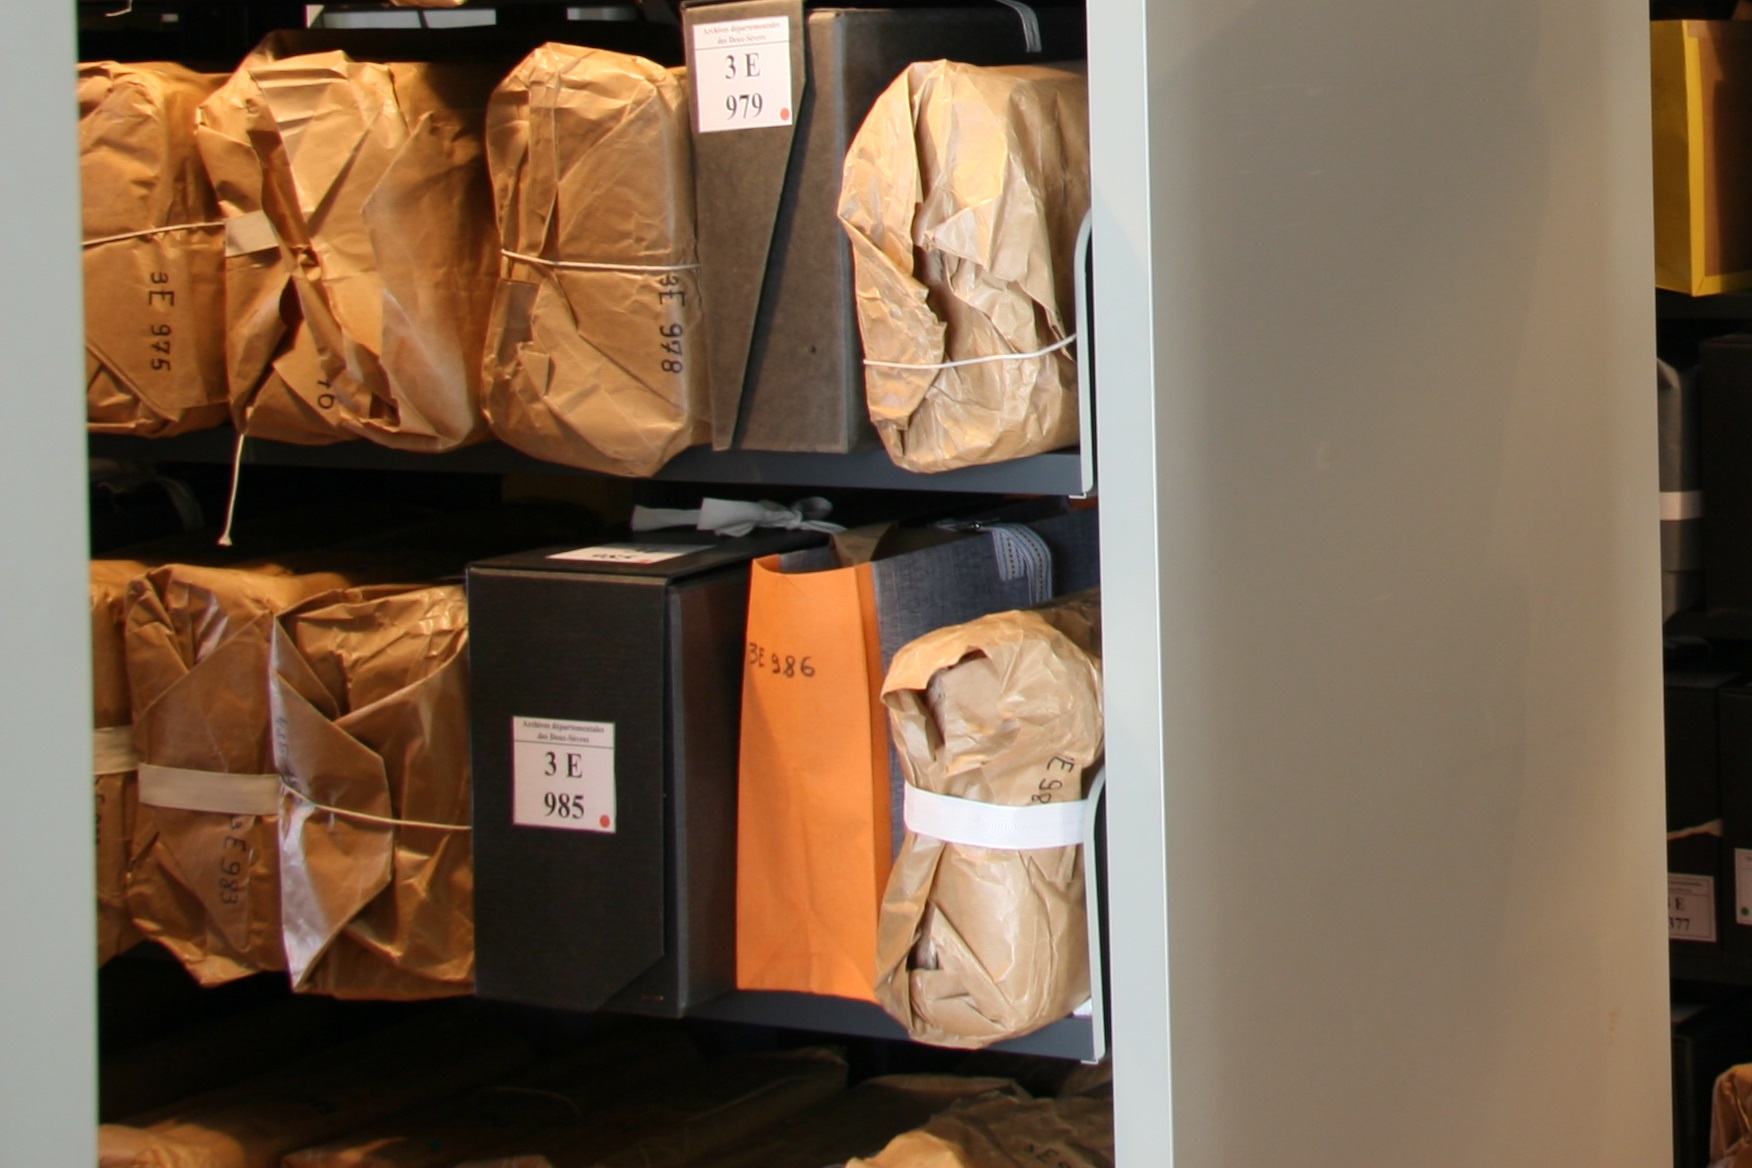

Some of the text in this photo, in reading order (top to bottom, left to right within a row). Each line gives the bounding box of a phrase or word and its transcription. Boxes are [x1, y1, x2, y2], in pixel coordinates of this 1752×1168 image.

[725, 53, 761, 79] 3 E
[726, 92, 763, 121] 979
[150, 324, 172, 372] 975
[660, 323, 683, 374] 978
[771, 653, 815, 678] 986
[544, 751, 583, 778] 3 E
[1031, 778, 1063, 804] 98
[544, 791, 584, 819] 985
[1675, 897, 1685, 911] E
